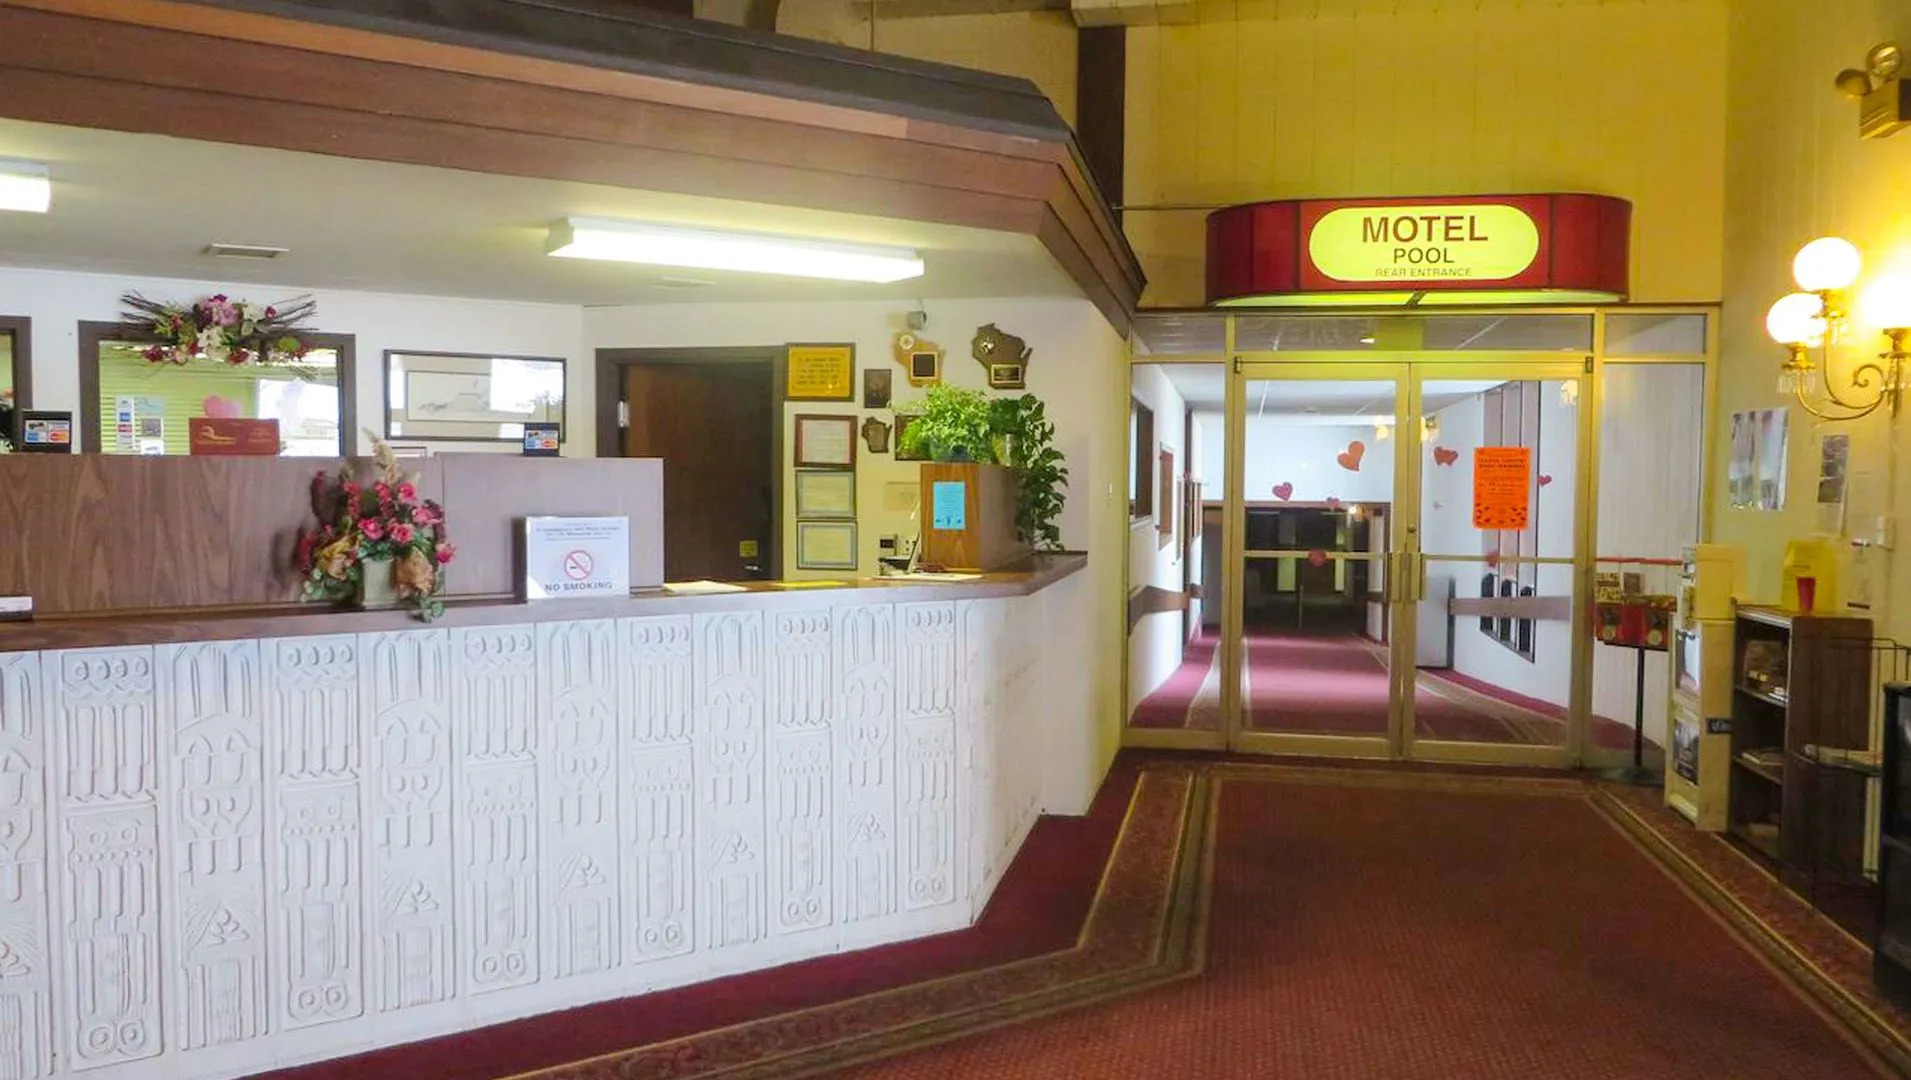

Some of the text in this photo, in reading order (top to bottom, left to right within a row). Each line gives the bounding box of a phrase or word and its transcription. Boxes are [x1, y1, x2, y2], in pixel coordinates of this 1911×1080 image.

[1363, 215, 1488, 242] MOTEL
[1393, 247, 1454, 264] POOL
[1375, 267, 1472, 277] REAR ENTRANCE
[545, 581, 613, 592] NO SMOKING
